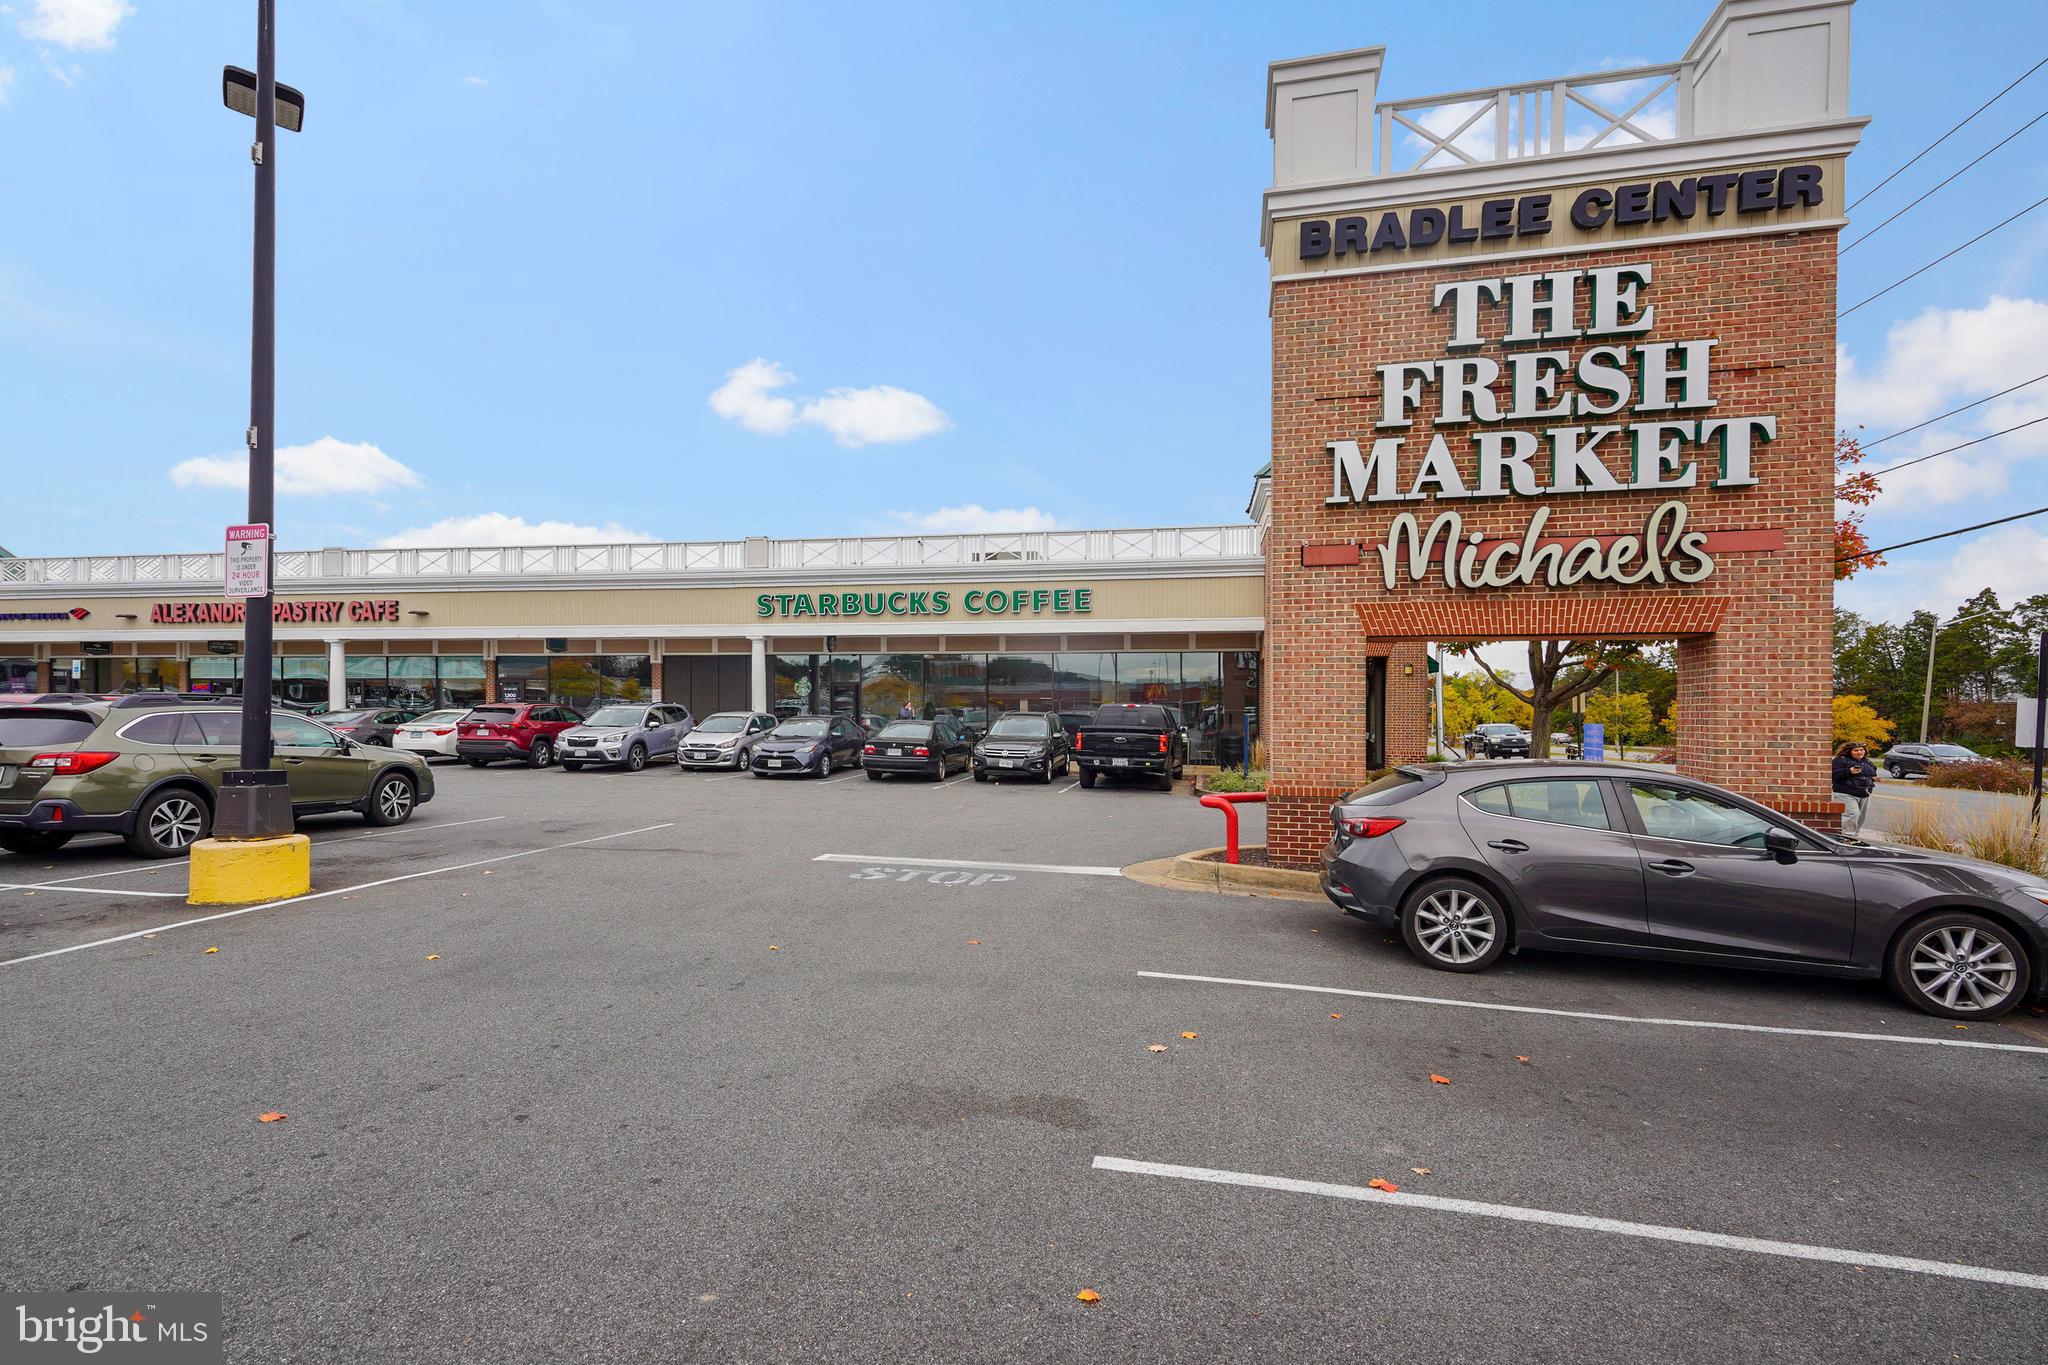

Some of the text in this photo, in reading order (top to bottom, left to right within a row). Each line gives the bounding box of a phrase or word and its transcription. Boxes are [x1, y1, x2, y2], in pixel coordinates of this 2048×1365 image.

[1299, 164, 1824, 260] BRADLEE CENTER
[1431, 262, 1655, 351] THE
[1375, 338, 1720, 430] FRESH
[1325, 414, 1777, 505] MARKET
[229, 528, 265, 540] WARNING
[1377, 499, 1716, 591] Michaels
[232, 571, 260, 580] 24 HOUR
[756, 588, 1093, 617] STARBUCKS COFFEE
[151, 600, 400, 623] ALEXANDR PASTRY CAFE
[849, 867, 1017, 886] STOP
